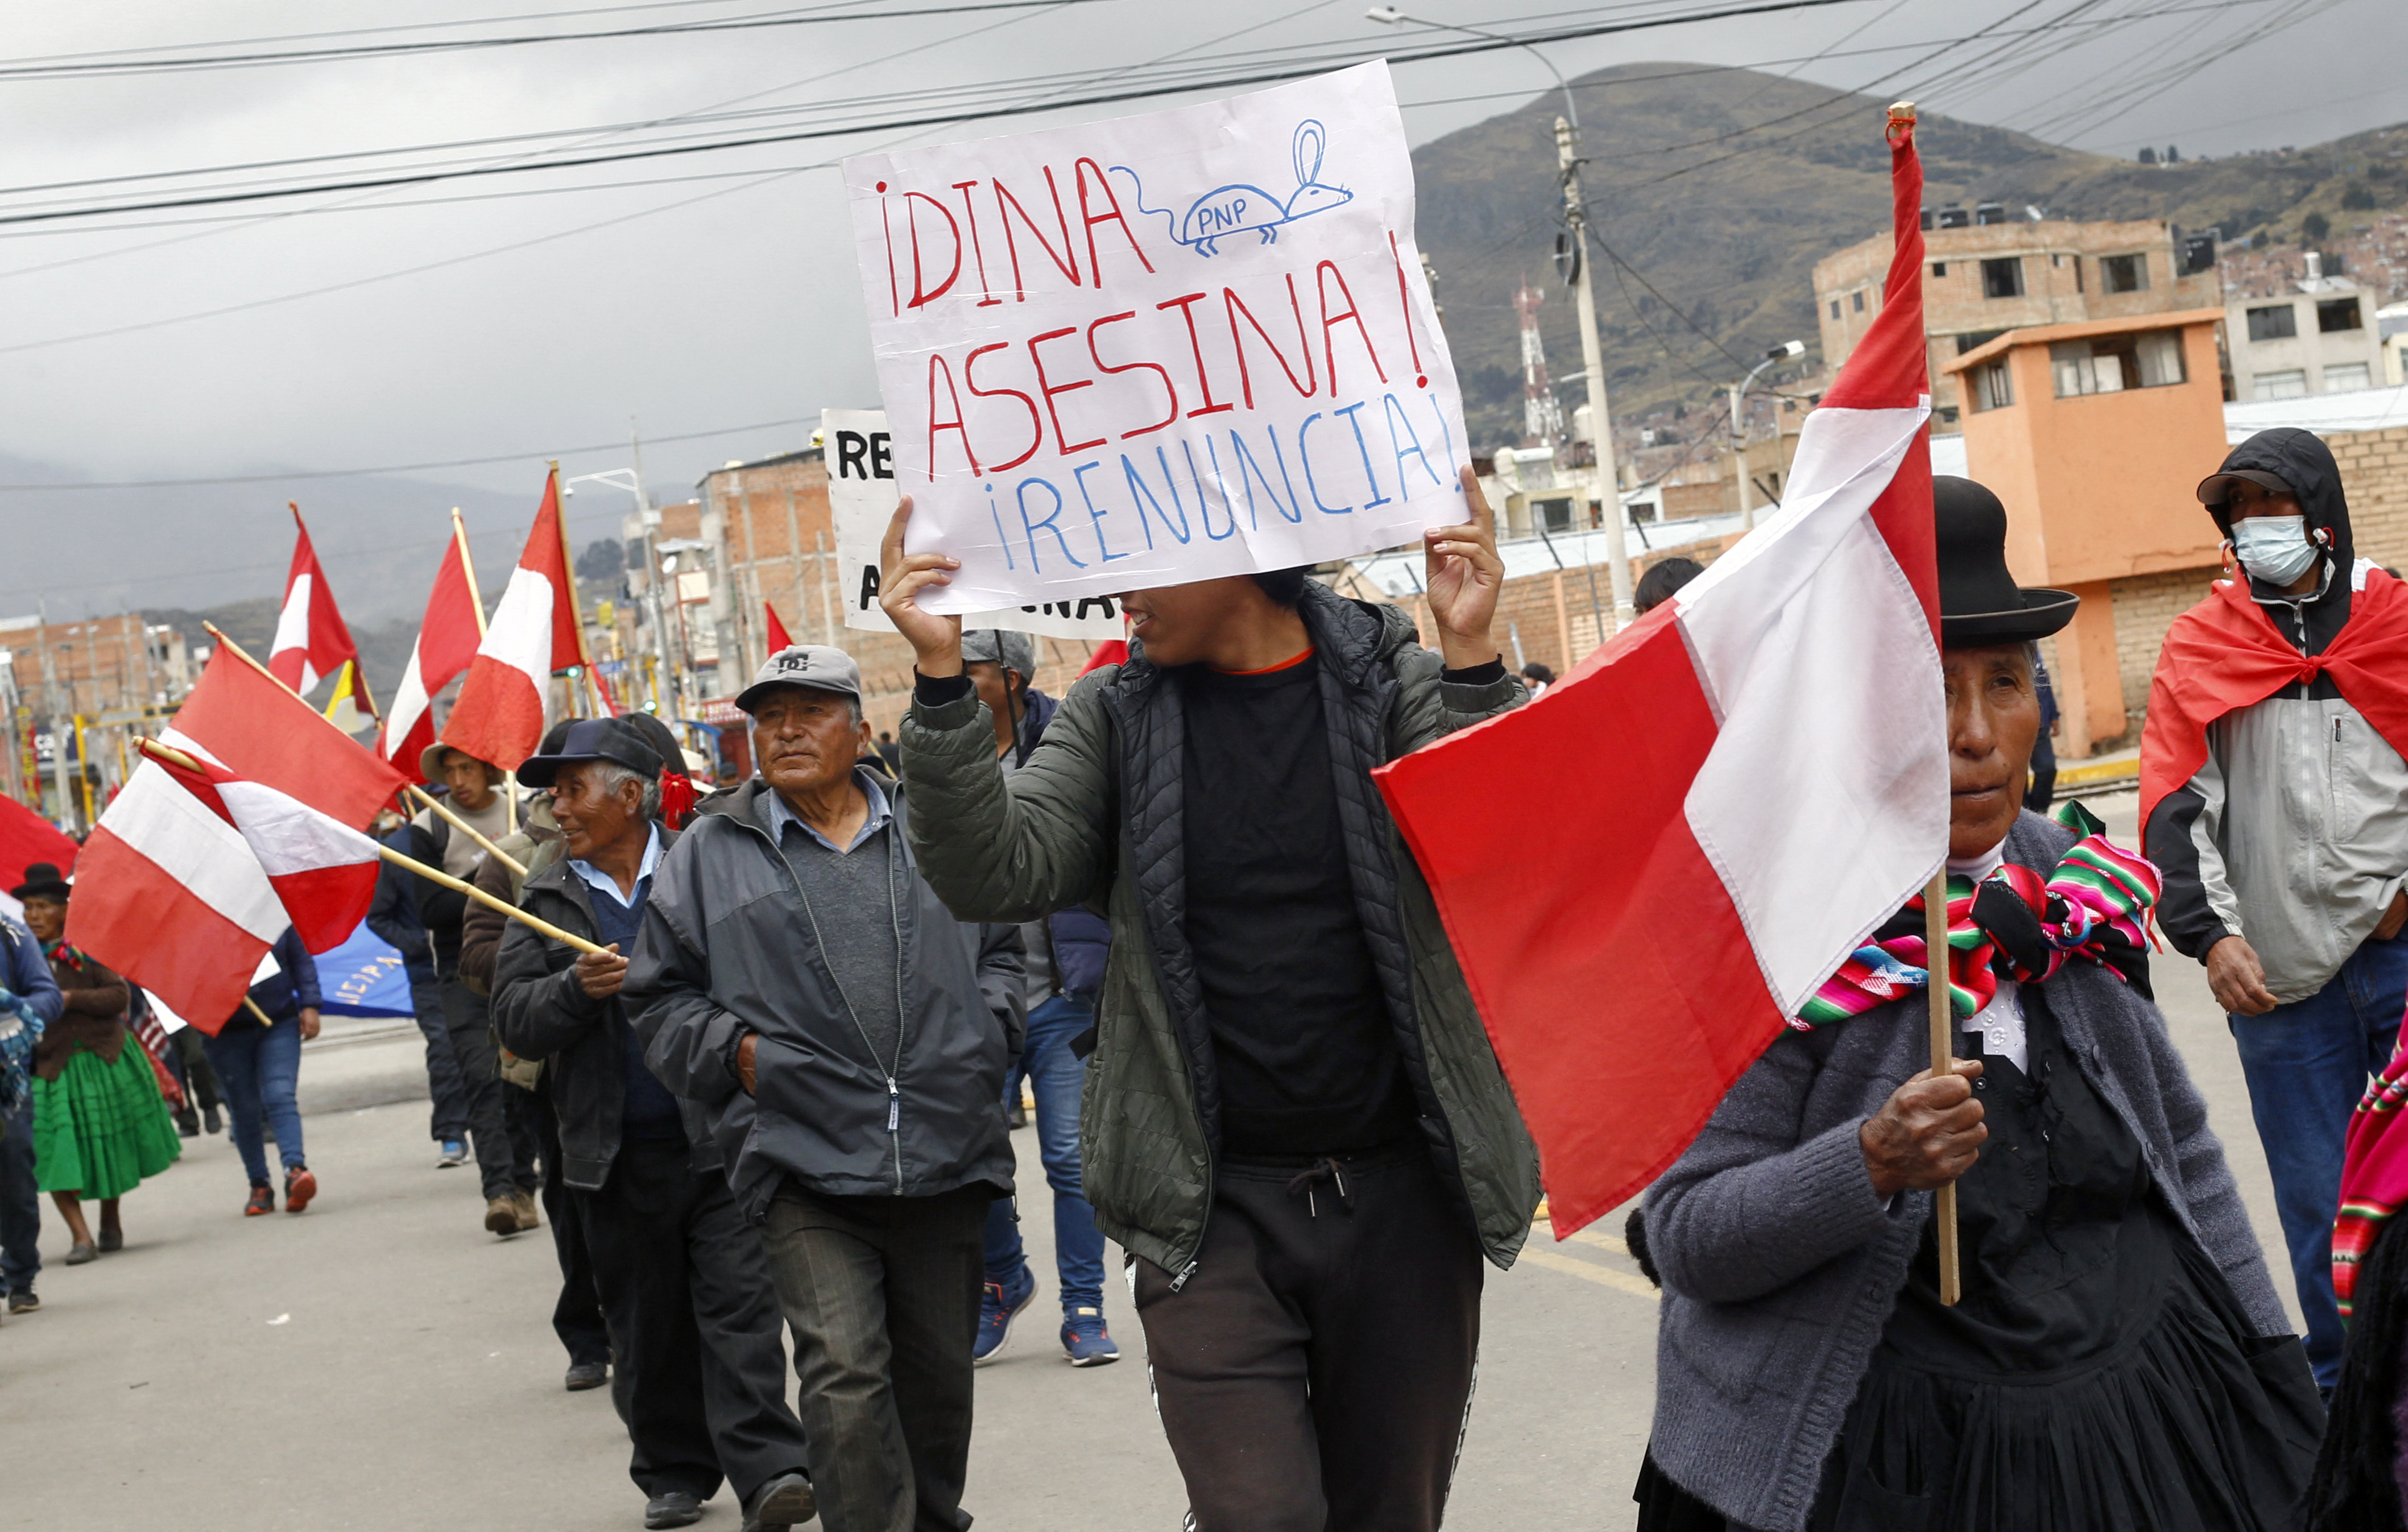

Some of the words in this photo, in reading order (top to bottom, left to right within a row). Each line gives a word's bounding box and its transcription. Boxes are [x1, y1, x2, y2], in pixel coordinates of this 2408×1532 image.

[876, 156, 1156, 317] ¡DINA
[1197, 198, 1246, 235] PNP
[928, 230, 1428, 483] ASESINA!
[984, 392, 1462, 574] ¡RENUNCIA!
[777, 653, 809, 675] DC
